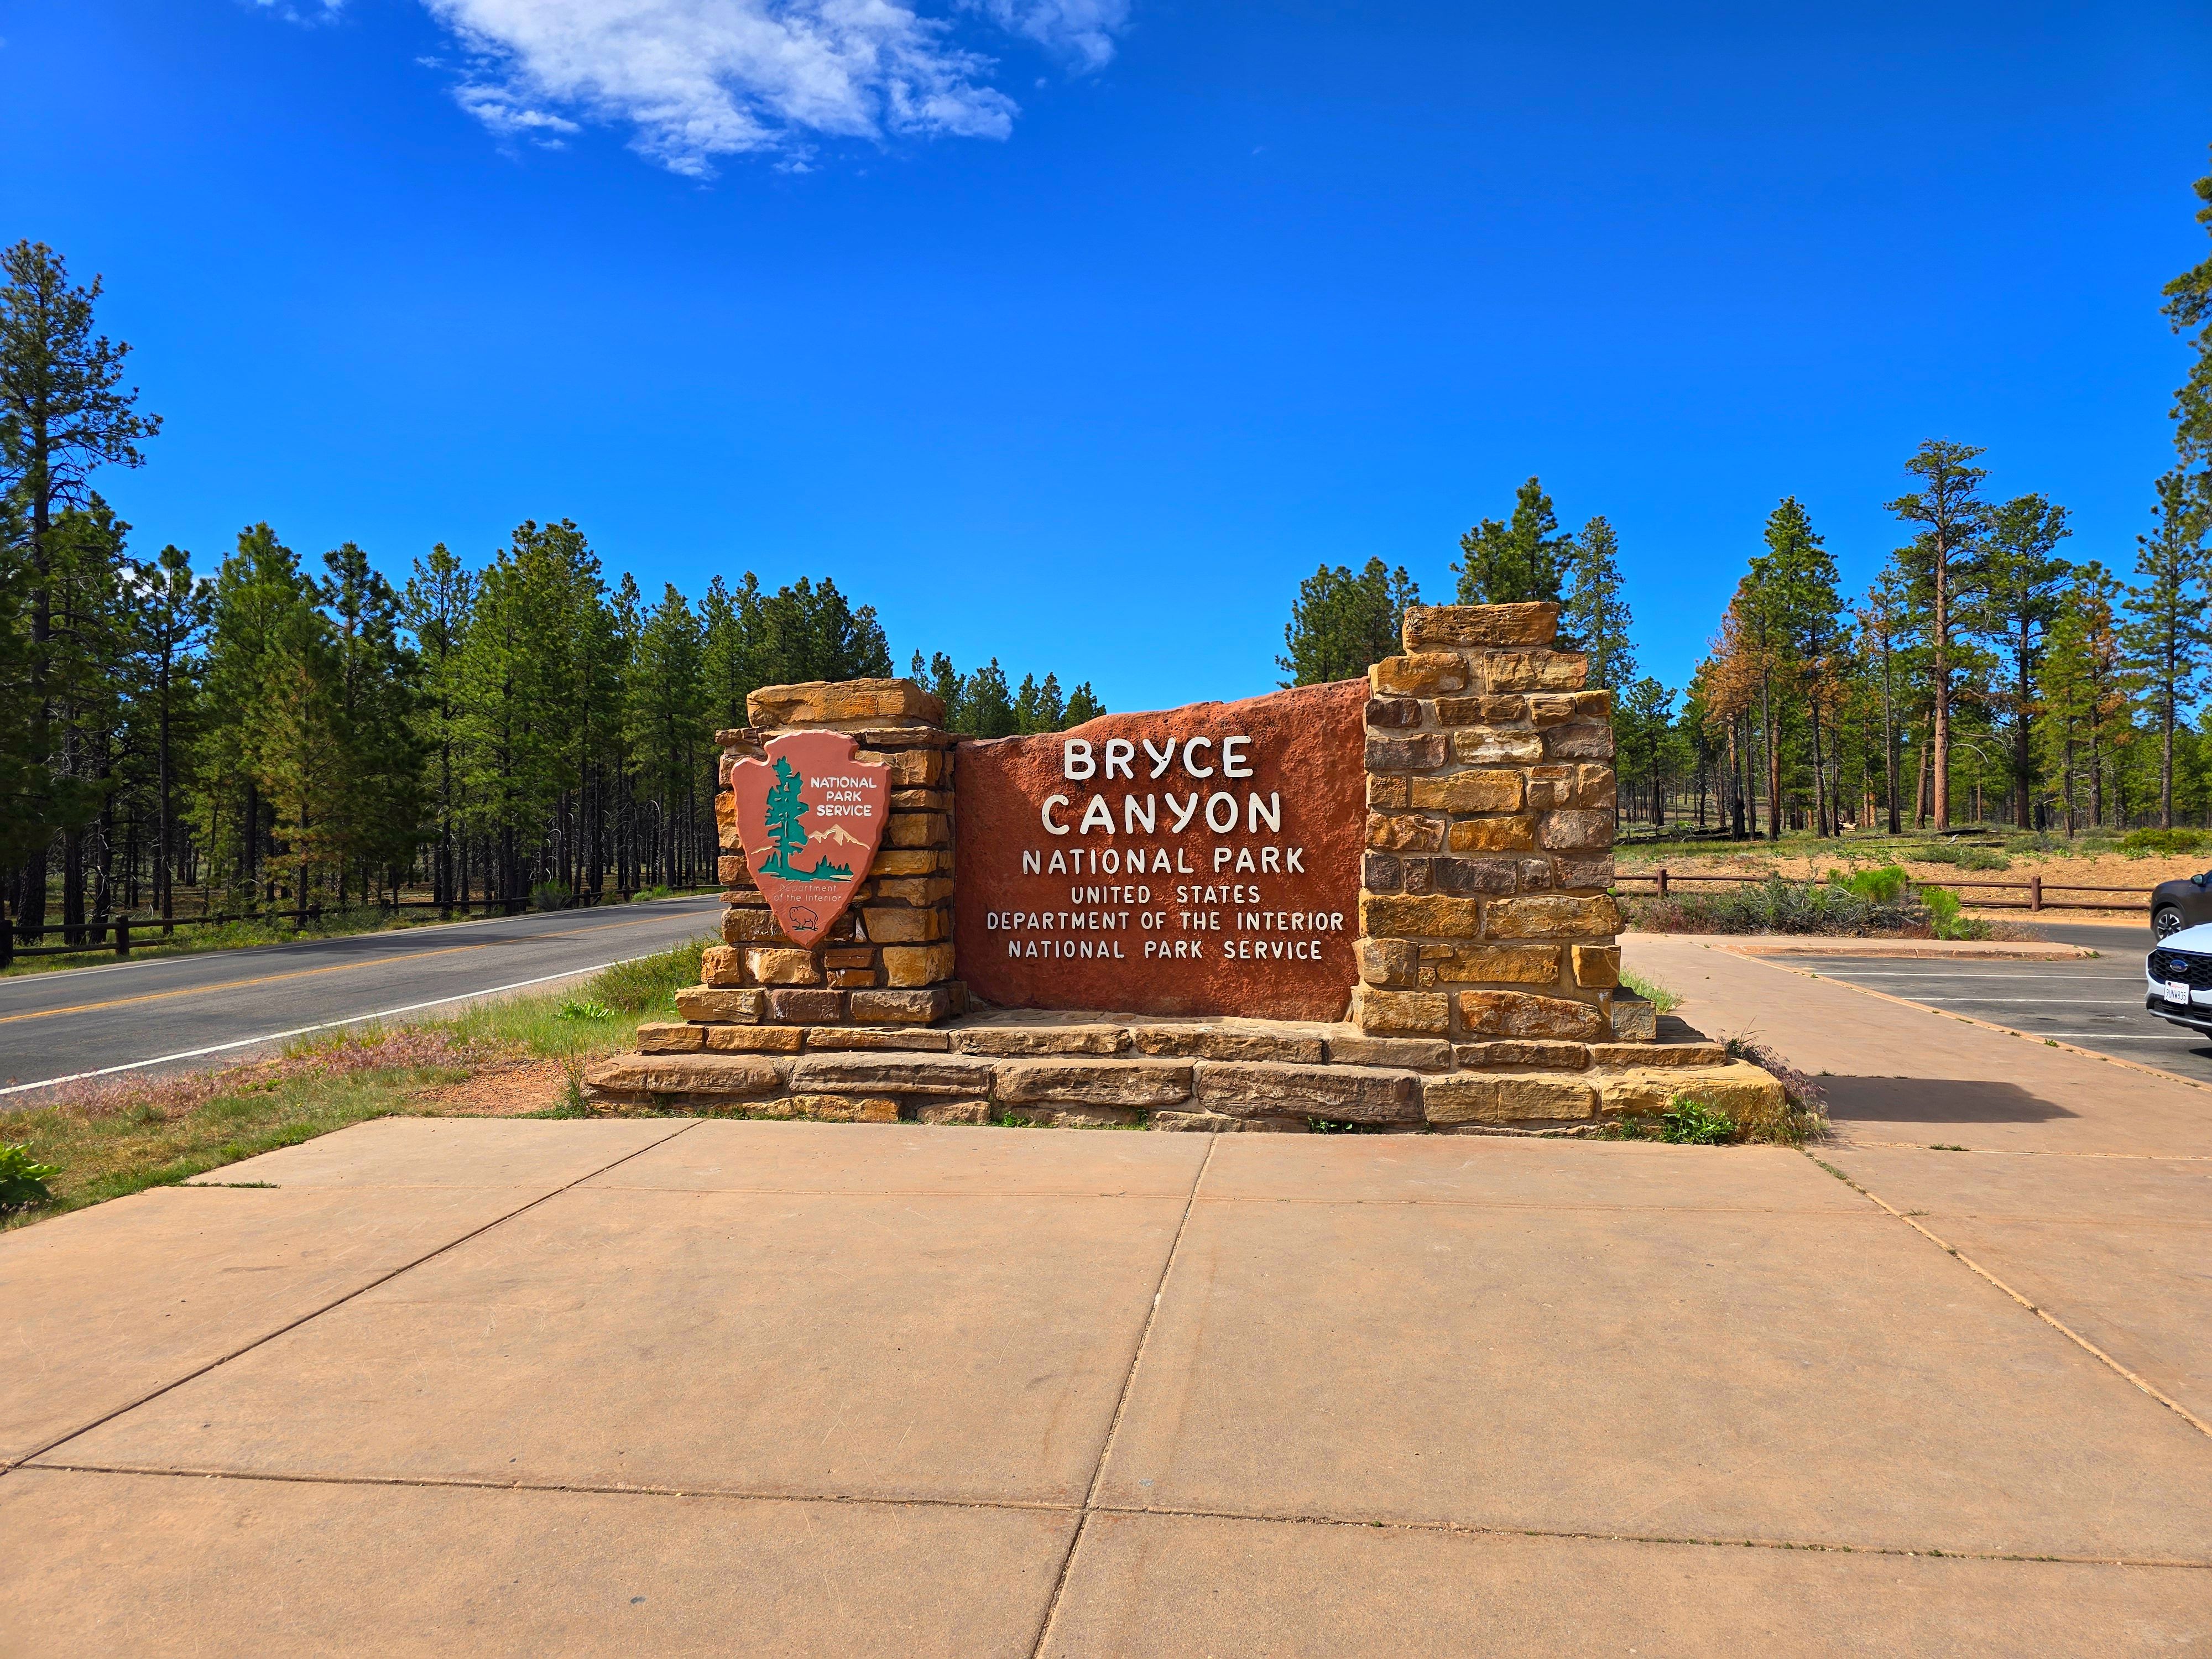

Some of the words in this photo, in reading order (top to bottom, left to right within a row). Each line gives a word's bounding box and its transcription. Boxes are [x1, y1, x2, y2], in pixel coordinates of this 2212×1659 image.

[1063, 735, 1254, 780] BRYCE
[810, 776, 877, 789] NATIONAL
[826, 790, 862, 802] PARK
[816, 804, 872, 816] SERVICE
[1041, 791, 1280, 835] CANYON
[1022, 848, 1194, 875] NATIONAL
[1214, 846, 1305, 873] PARK
[780, 884, 836, 893] Department
[1071, 885, 1150, 904] UNITED
[1176, 885, 1260, 904] STATES
[987, 911, 1129, 930] DEPARTMENT
[1141, 911, 1166, 930] OF
[1180, 911, 1220, 930] THE
[1238, 911, 1344, 931] INTERIOR
[1009, 940, 1125, 958] NATIONAL
[1145, 940, 1203, 958] PARK
[1224, 940, 1322, 959] SERVICE
